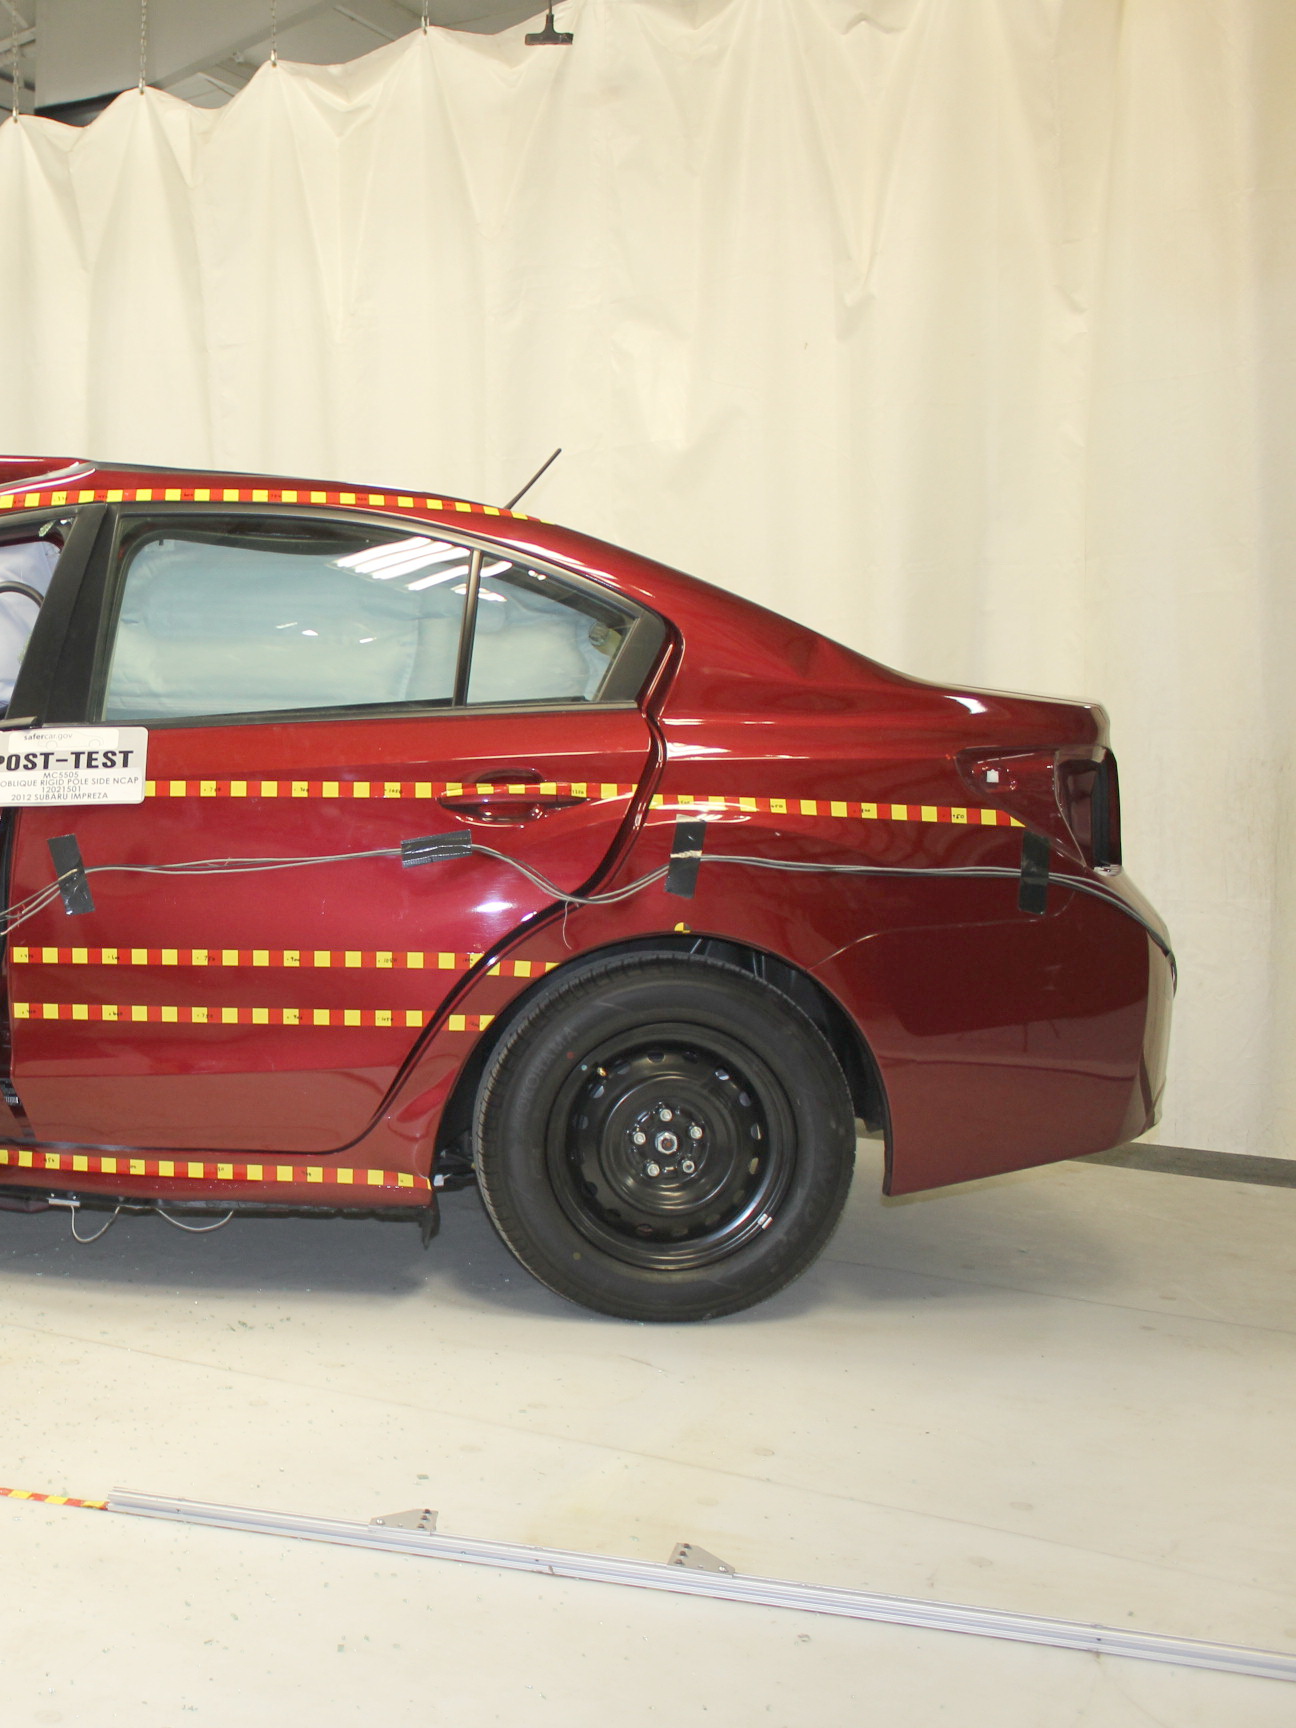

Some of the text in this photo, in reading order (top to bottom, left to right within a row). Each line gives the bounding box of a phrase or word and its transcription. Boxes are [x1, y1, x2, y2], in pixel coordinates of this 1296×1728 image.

[23, 731, 73, 741] safercar.gov
[42, 771, 79, 779] MC5505
[0, 779, 38, 787] OBLIQUE
[40, 778, 65, 786] RIGID
[67, 777, 89, 786] POLE
[91, 777, 110, 785] SIDE
[113, 776, 139, 784] NCAP
[42, 785, 82, 793] 12021501
[11, 792, 109, 801] 2012 SUBARU IMPREZA
[511, 1025, 579, 1124] OKOHAMA
